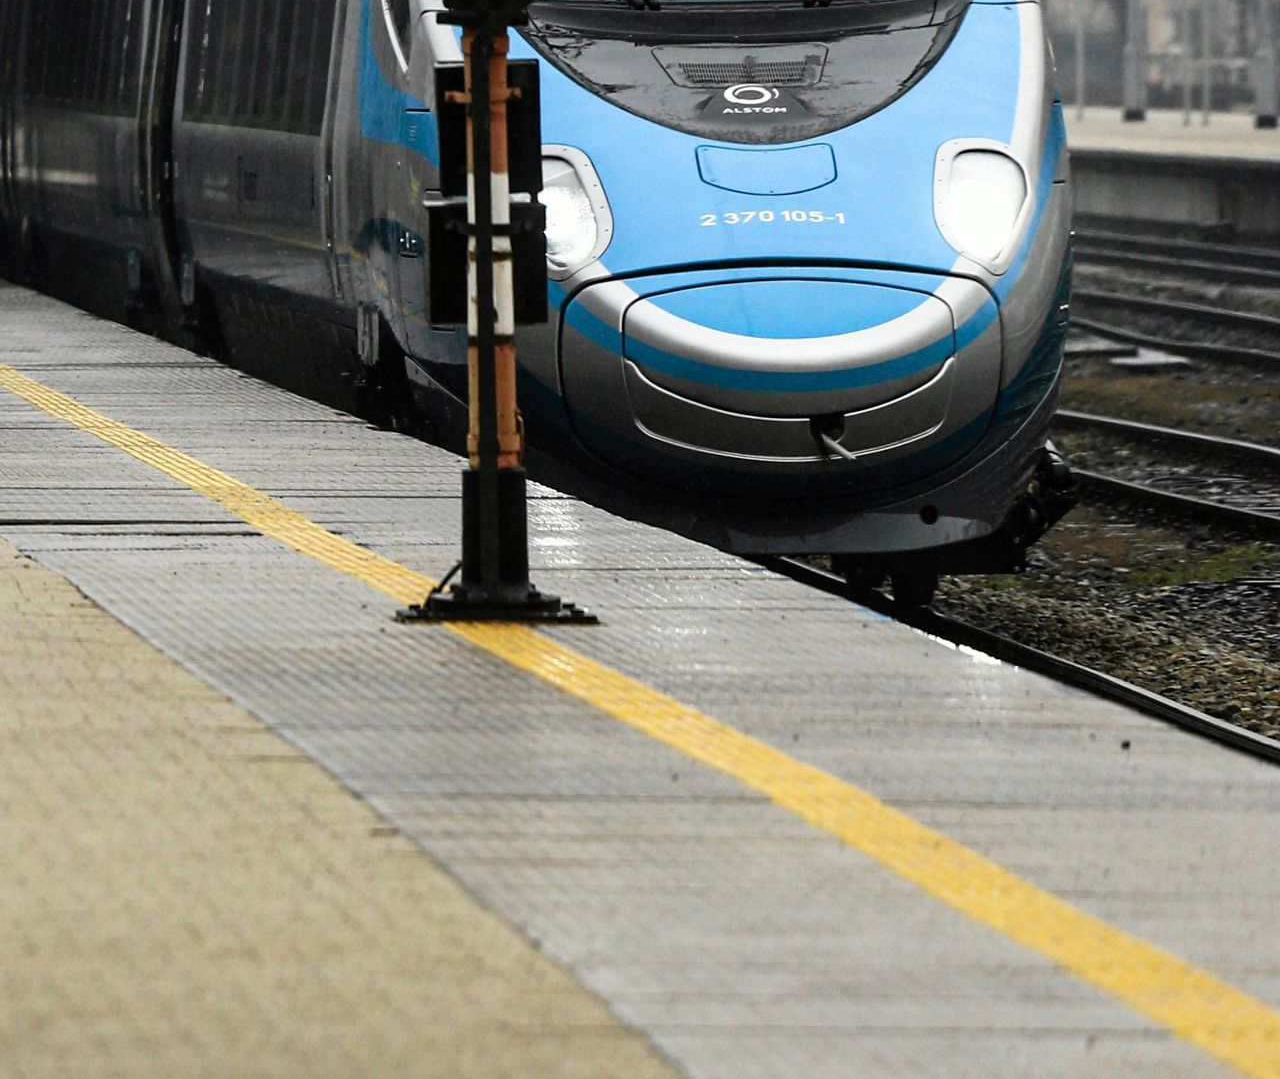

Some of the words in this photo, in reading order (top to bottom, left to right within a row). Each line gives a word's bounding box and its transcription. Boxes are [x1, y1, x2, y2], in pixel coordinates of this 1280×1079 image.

[700, 214, 718, 227] 2
[723, 210, 775, 225] 370
[780, 210, 846, 225] 105-1
